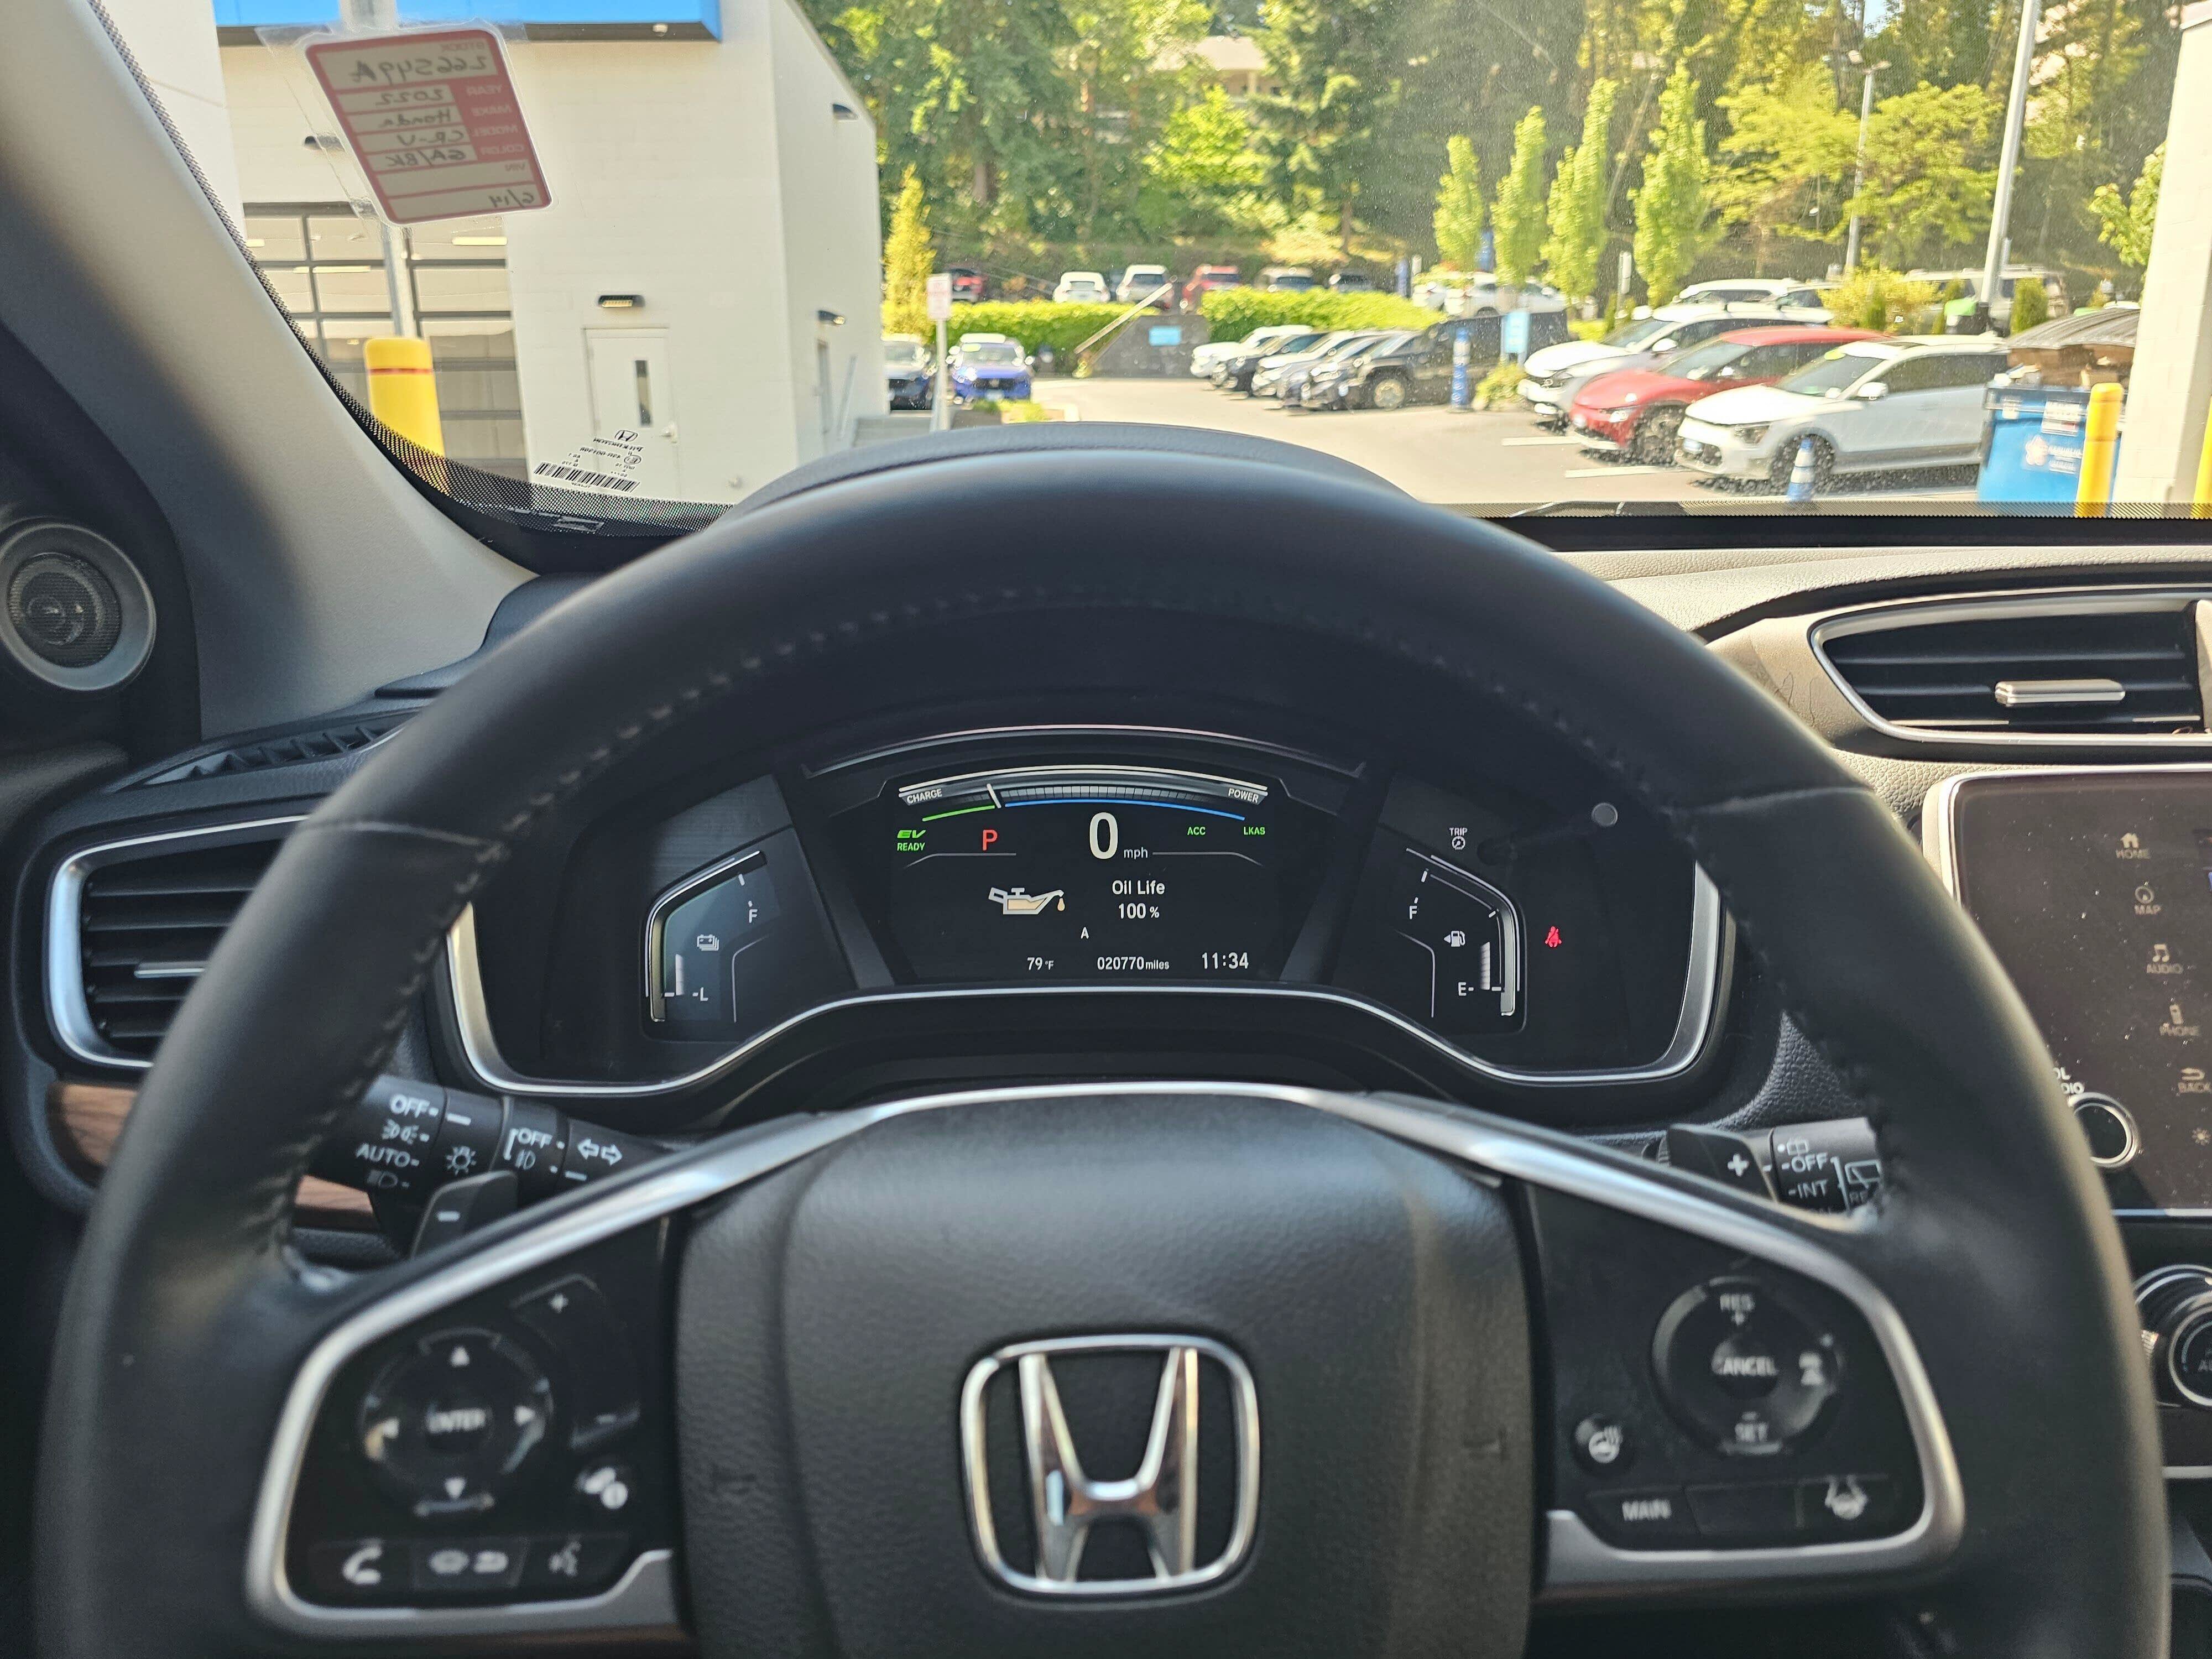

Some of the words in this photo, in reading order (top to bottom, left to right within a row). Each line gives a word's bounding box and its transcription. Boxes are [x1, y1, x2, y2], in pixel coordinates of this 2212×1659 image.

[906, 789, 943, 804] CHARGE
[1228, 787, 1259, 804] POWER
[897, 830, 927, 838] EV
[1089, 812, 1118, 859] 0
[1124, 847, 1148, 860] mph
[1187, 826, 1206, 836] ACC
[1243, 826, 1266, 836] LKAS
[1449, 827, 1468, 836] TRIP
[896, 842, 926, 851] READY
[982, 830, 998, 851] P
[1112, 880, 1131, 895] Oil
[1137, 880, 1165, 895] Life
[749, 909, 758, 924] F
[1118, 902, 1147, 919] 100
[1410, 905, 1418, 920] F
[2134, 904, 2162, 915] MAP
[1081, 926, 1089, 939] A
[1202, 952, 1249, 969] 11:34
[2146, 963, 2183, 974] AUDIO
[2052, 1067, 2072, 1080] OL
[2060, 1082, 2085, 1094] DIO
[389, 1093, 429, 1118] OFF
[517, 1127, 552, 1149] OFF
[355, 1142, 411, 1167] AUTO
[1791, 1152, 1828, 1173] OFF
[1797, 1180, 1829, 1199] INT
